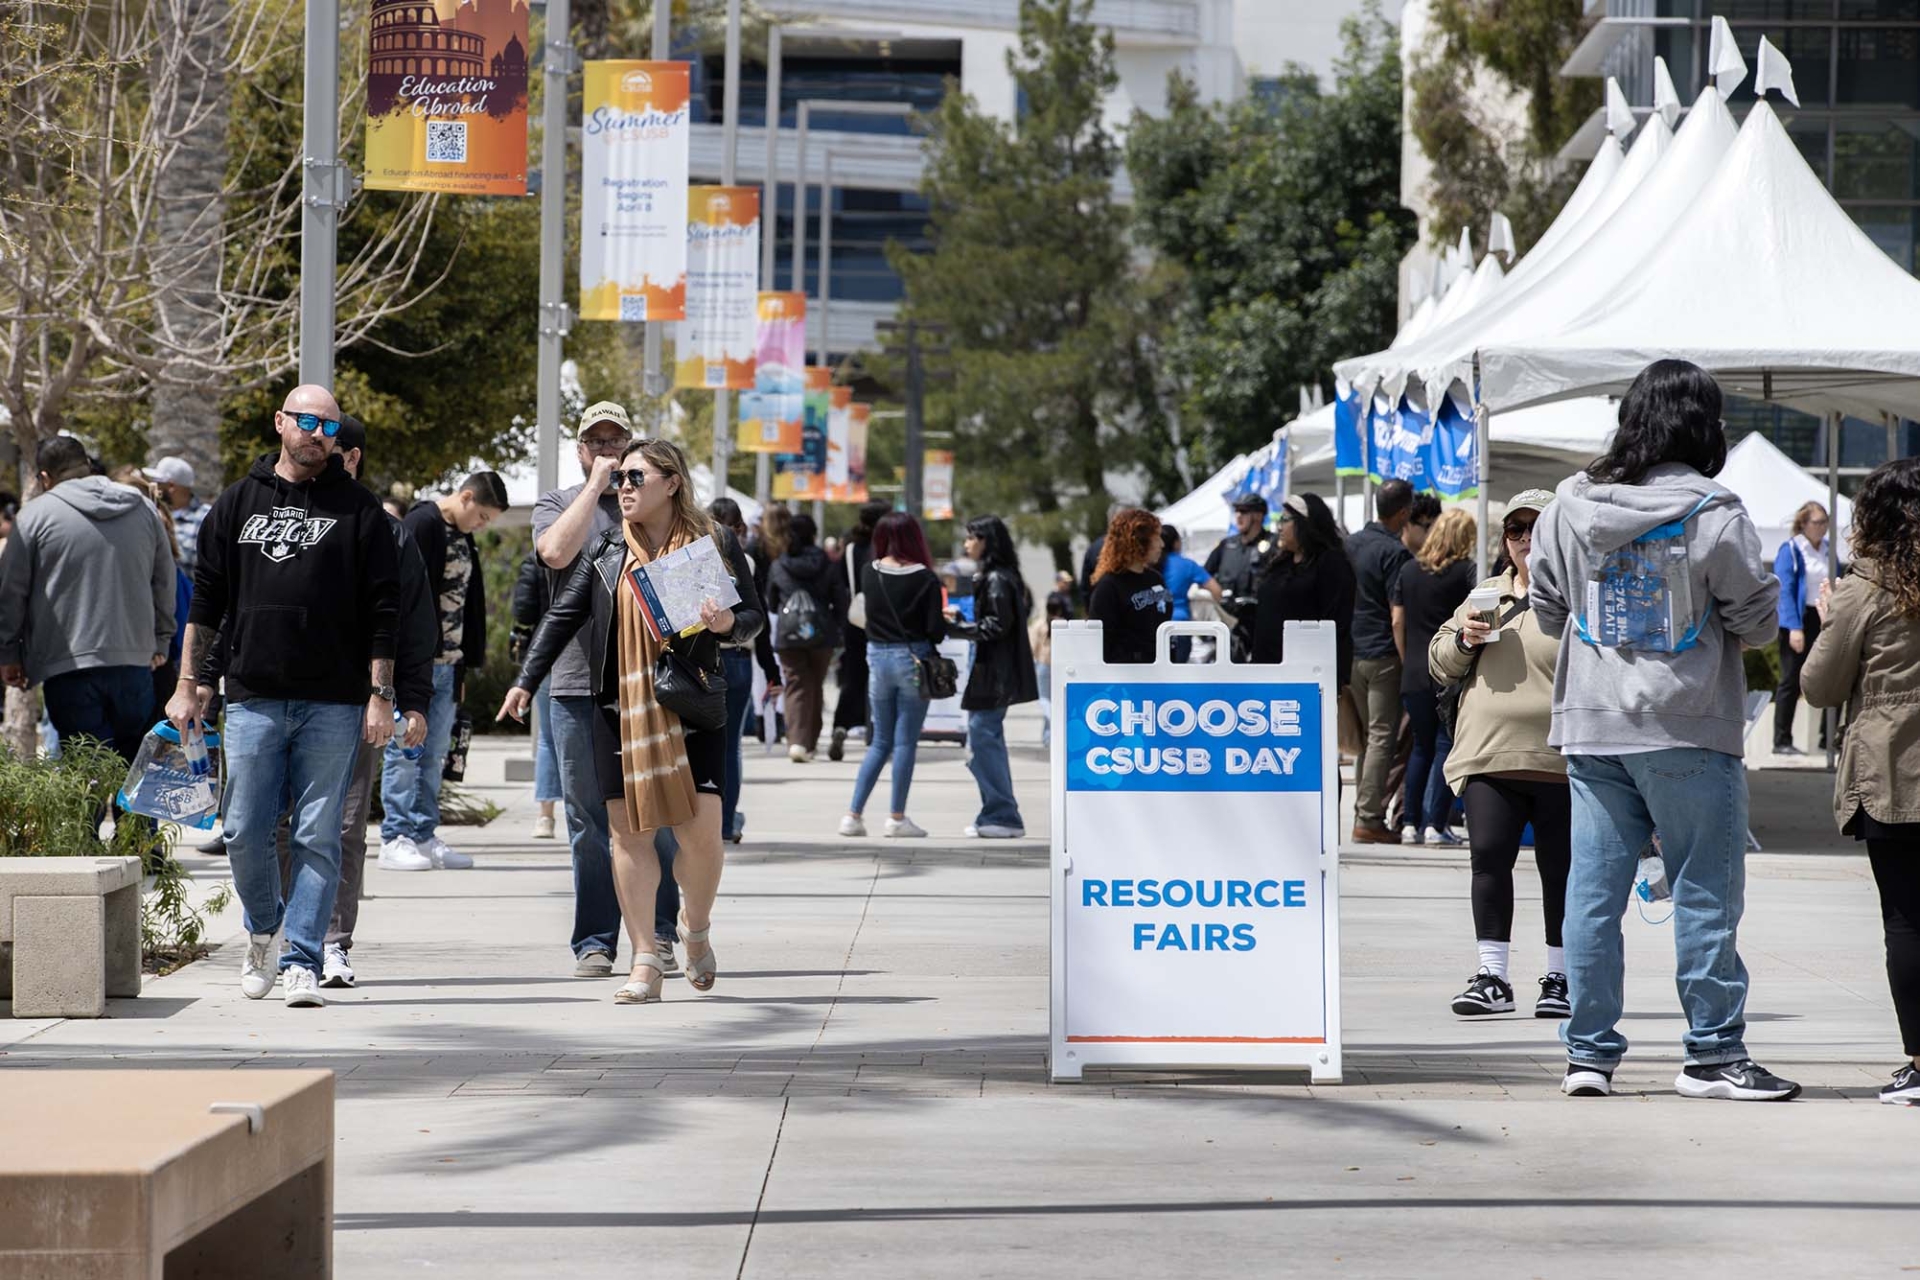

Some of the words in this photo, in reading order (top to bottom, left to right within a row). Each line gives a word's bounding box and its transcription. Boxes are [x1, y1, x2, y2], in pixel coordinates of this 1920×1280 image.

[398, 75, 497, 97] Education
[411, 94, 488, 117] Abroad
[586, 106, 685, 135] Summer
[383, 168, 424, 177] Education
[424, 169, 453, 179] Abroad
[454, 170, 491, 182] financing
[493, 172, 509, 180] and
[402, 181, 450, 189] larships
[602, 177, 668, 189] Registration
[616, 191, 653, 202] begins
[616, 202, 643, 213] April
[272, 510, 304, 520] ONTARIO
[242, 517, 332, 542] REIGN
[1605, 604, 1616, 636] LIVE
[1617, 616, 1627, 643] THE
[1085, 699, 1301, 737] CHOOSE
[1086, 747, 1211, 775] CSUSB
[1225, 747, 1301, 775] DAY
[1082, 879, 1306, 908] RESOURCE
[1133, 923, 1257, 952] FAIRS
